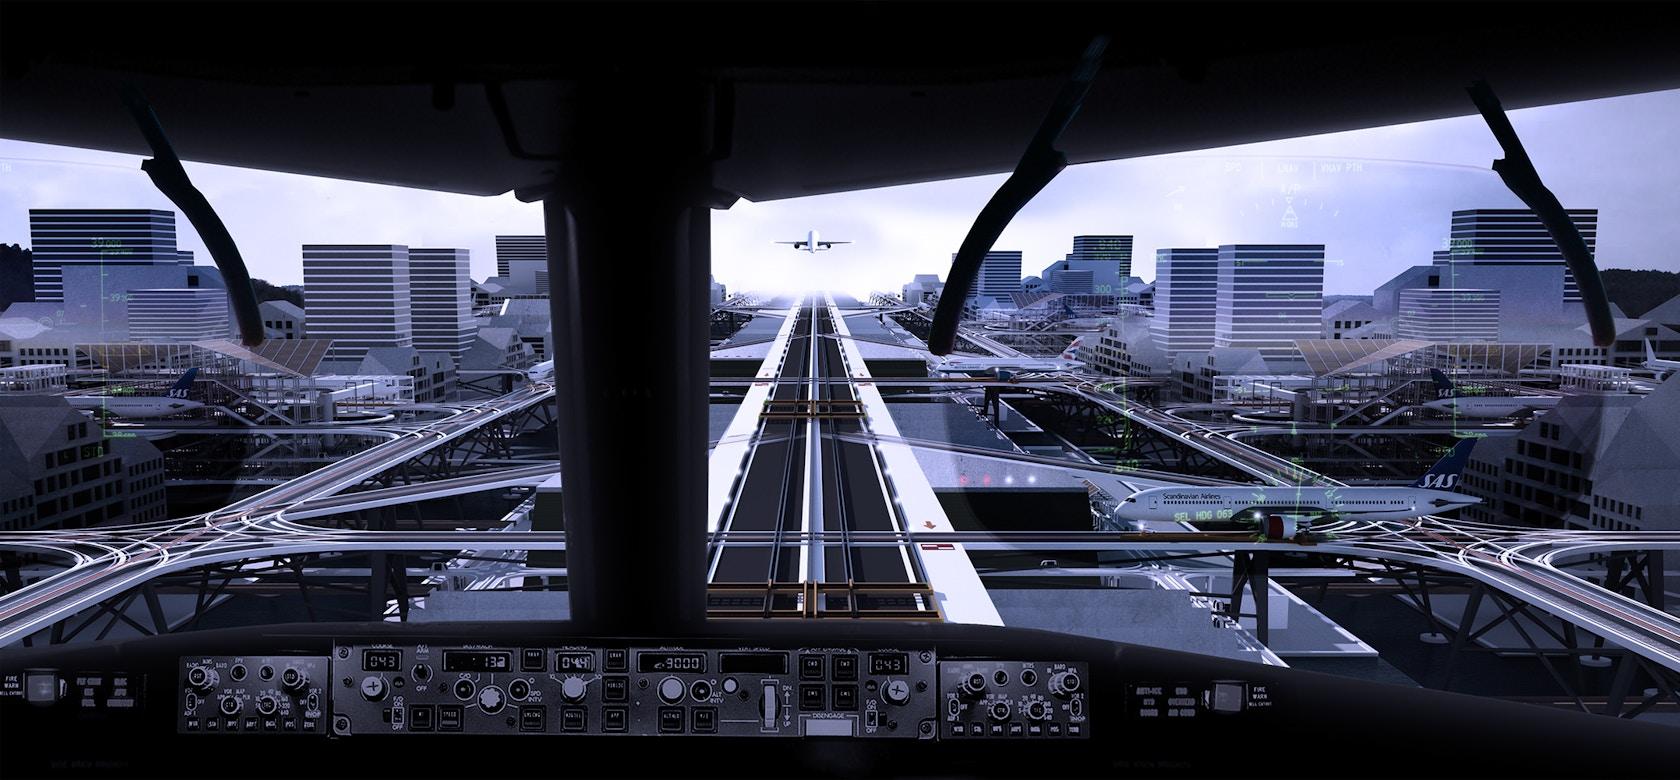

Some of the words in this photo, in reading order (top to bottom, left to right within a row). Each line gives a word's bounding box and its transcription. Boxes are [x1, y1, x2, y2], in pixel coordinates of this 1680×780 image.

[169, 388, 190, 398] SAS
[1438, 388, 1454, 398] SAS
[1418, 473, 1458, 489] SAS
[1162, 492, 1200, 500] Scandinavian
[1201, 492, 1222, 500] Airlines
[1174, 512, 1191, 522] SEL
[1196, 511, 1213, 521] HDG
[1216, 509, 1233, 519] 063
[370, 656, 396, 667] 043
[875, 659, 901, 671] 043
